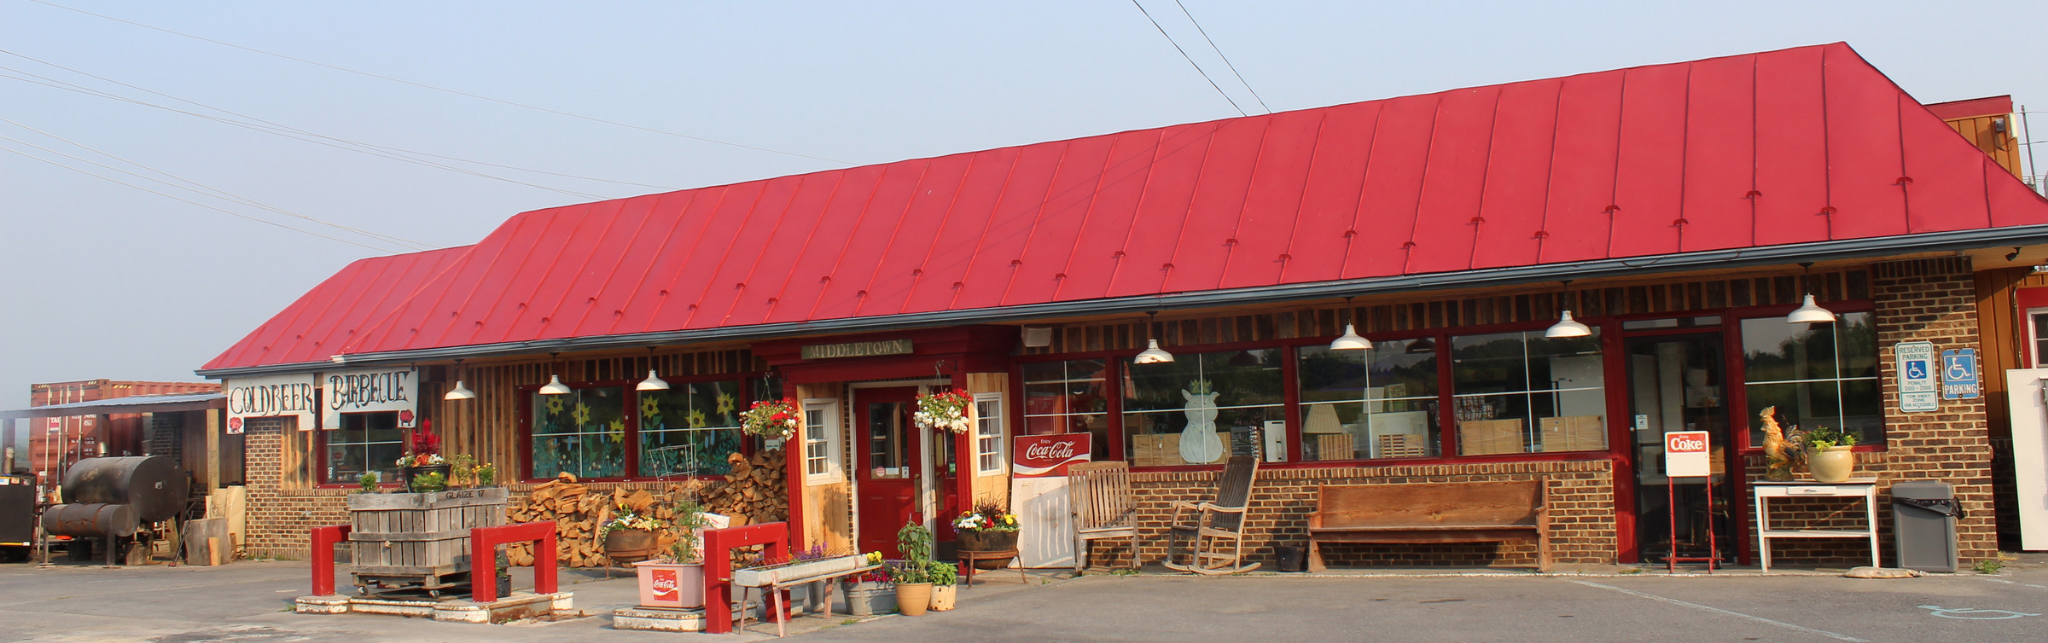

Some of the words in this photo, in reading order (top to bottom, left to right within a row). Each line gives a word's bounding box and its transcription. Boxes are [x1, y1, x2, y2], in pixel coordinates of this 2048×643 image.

[810, 339, 903, 358] MIDDLETOWN
[329, 371, 411, 410] BARBECUE
[1945, 384, 1977, 395] PARKING
[1670, 437, 1703, 451] Coke
[446, 490, 473, 499] GLAIZE
